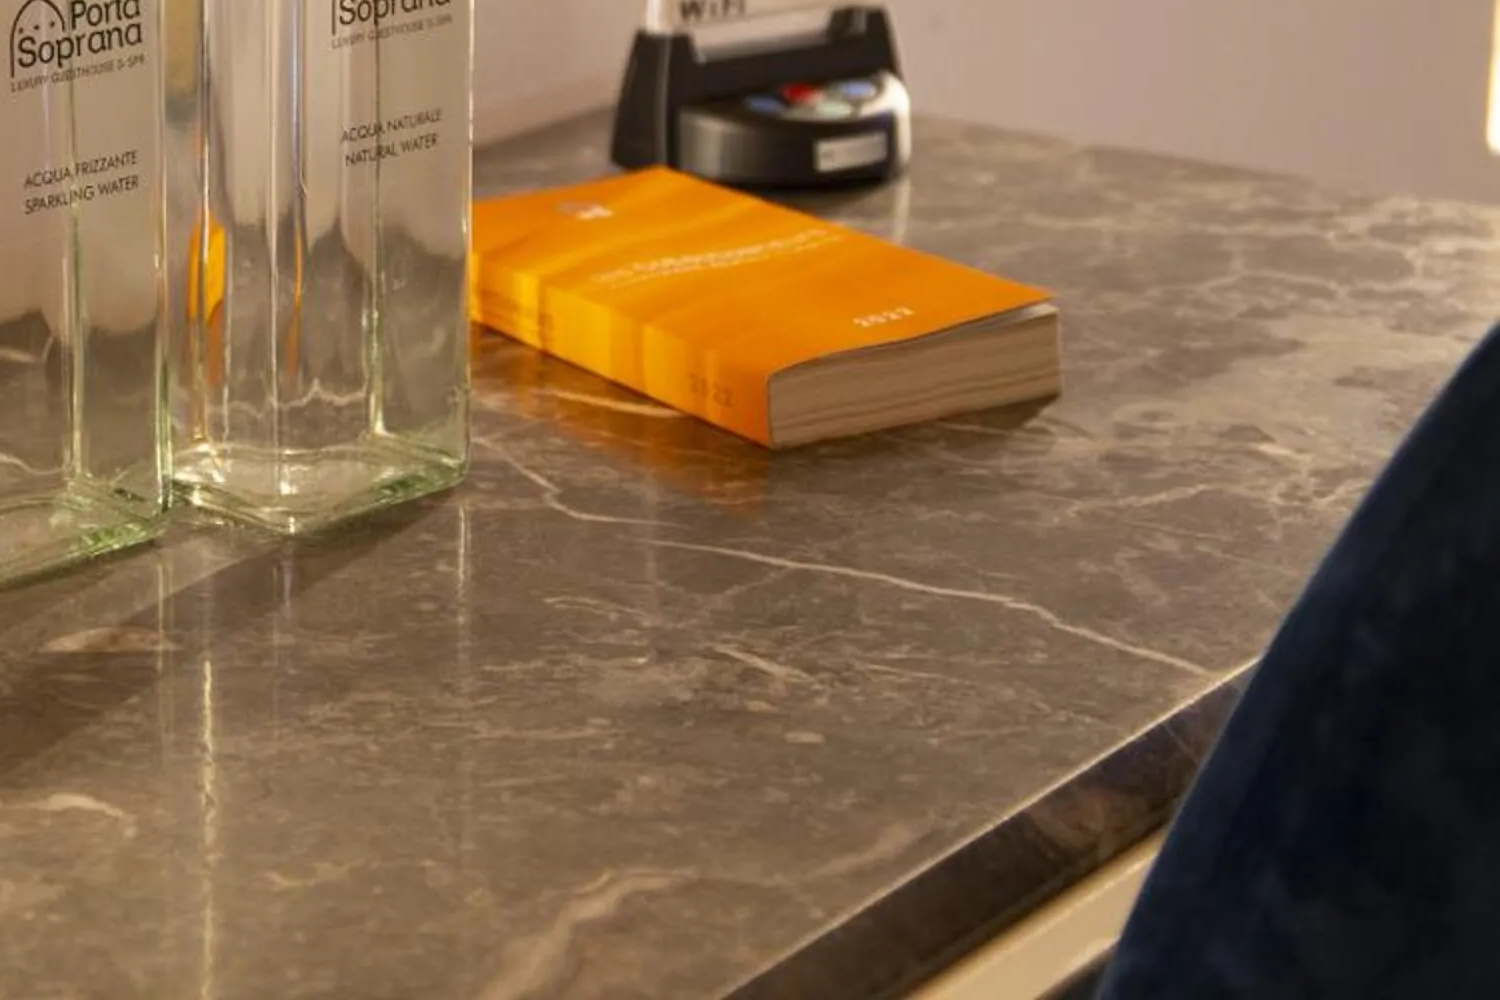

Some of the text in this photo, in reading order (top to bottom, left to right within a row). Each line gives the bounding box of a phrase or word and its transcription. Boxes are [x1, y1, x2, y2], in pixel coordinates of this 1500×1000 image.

[18, 21, 143, 68] Soprana
[341, 107, 443, 143] ACQUA NATURALE
[345, 131, 440, 168] NATURAL WATER
[23, 150, 138, 189] ACQUA FRIZZANTE
[24, 174, 139, 216] SPARKLING WATER
